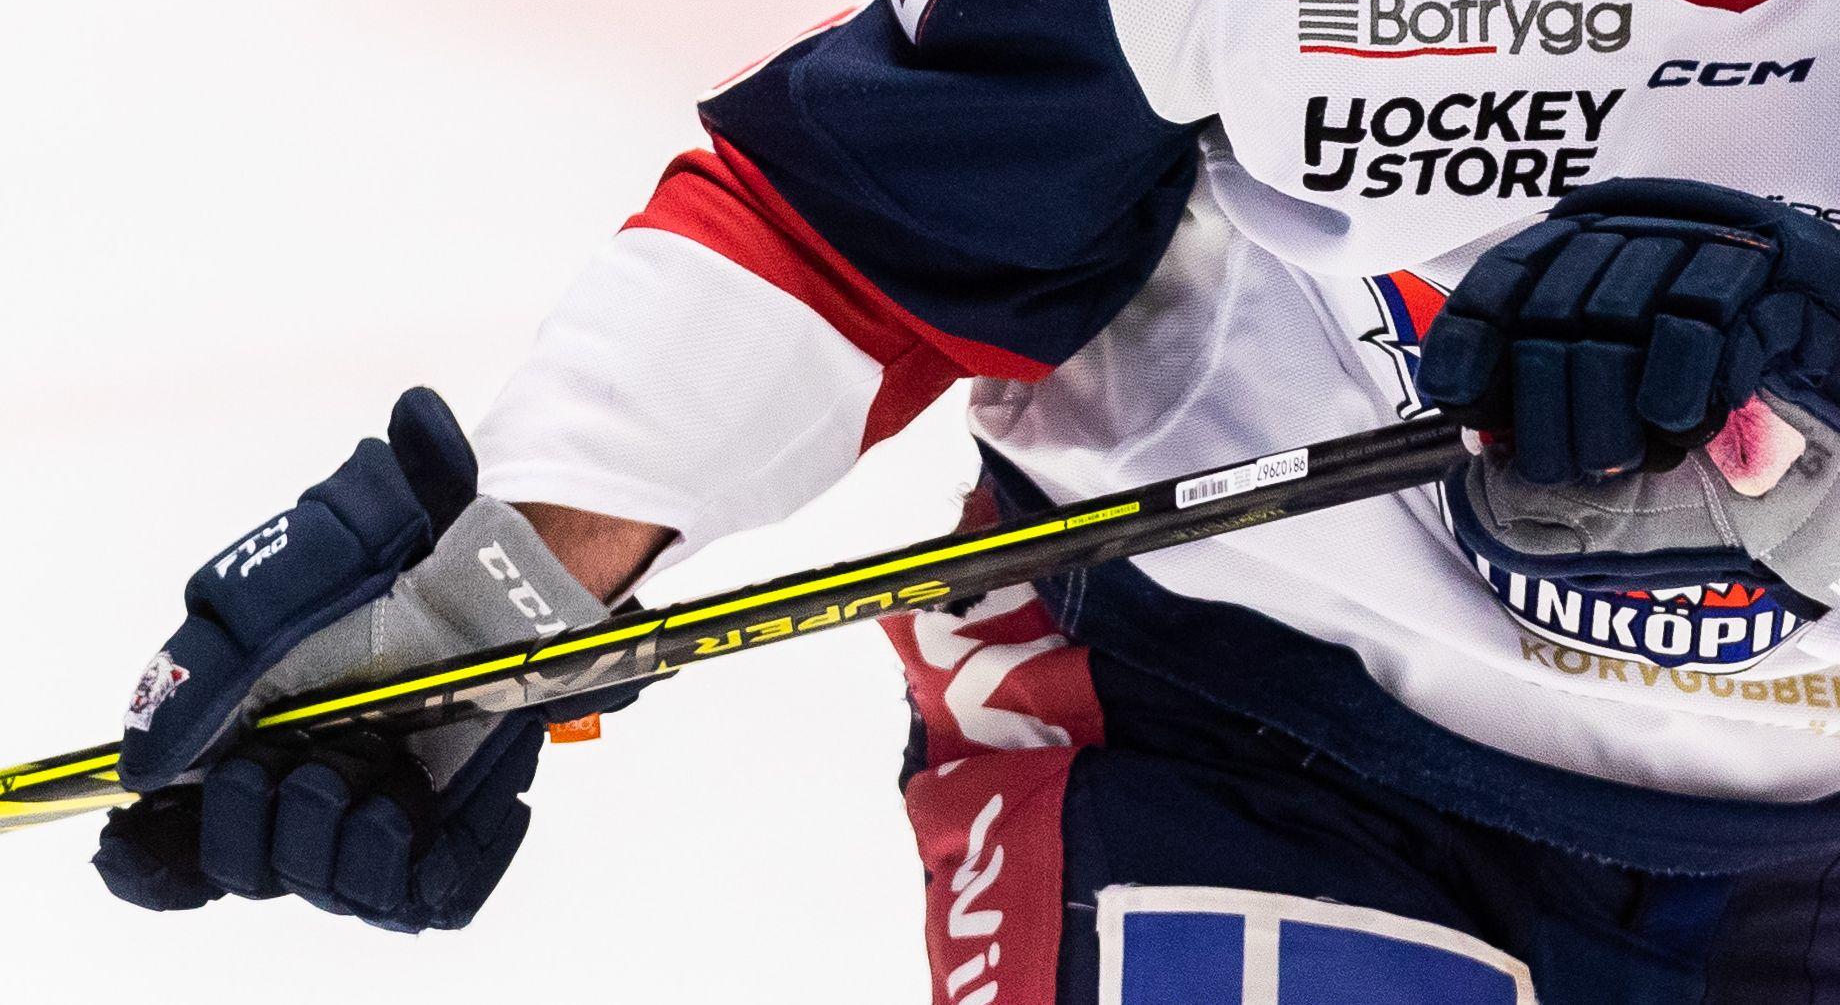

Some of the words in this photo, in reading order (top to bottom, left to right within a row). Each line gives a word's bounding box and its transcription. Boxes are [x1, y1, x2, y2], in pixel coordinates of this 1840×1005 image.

[1646, 56, 1817, 90] CCM
[1303, 88, 1627, 166] HOCKEY
[1361, 145, 1600, 198] STORE
[1256, 456, 1306, 482] 98102967
[693, 580, 951, 655] SUPER
[1476, 552, 1797, 658] INKÖPI
